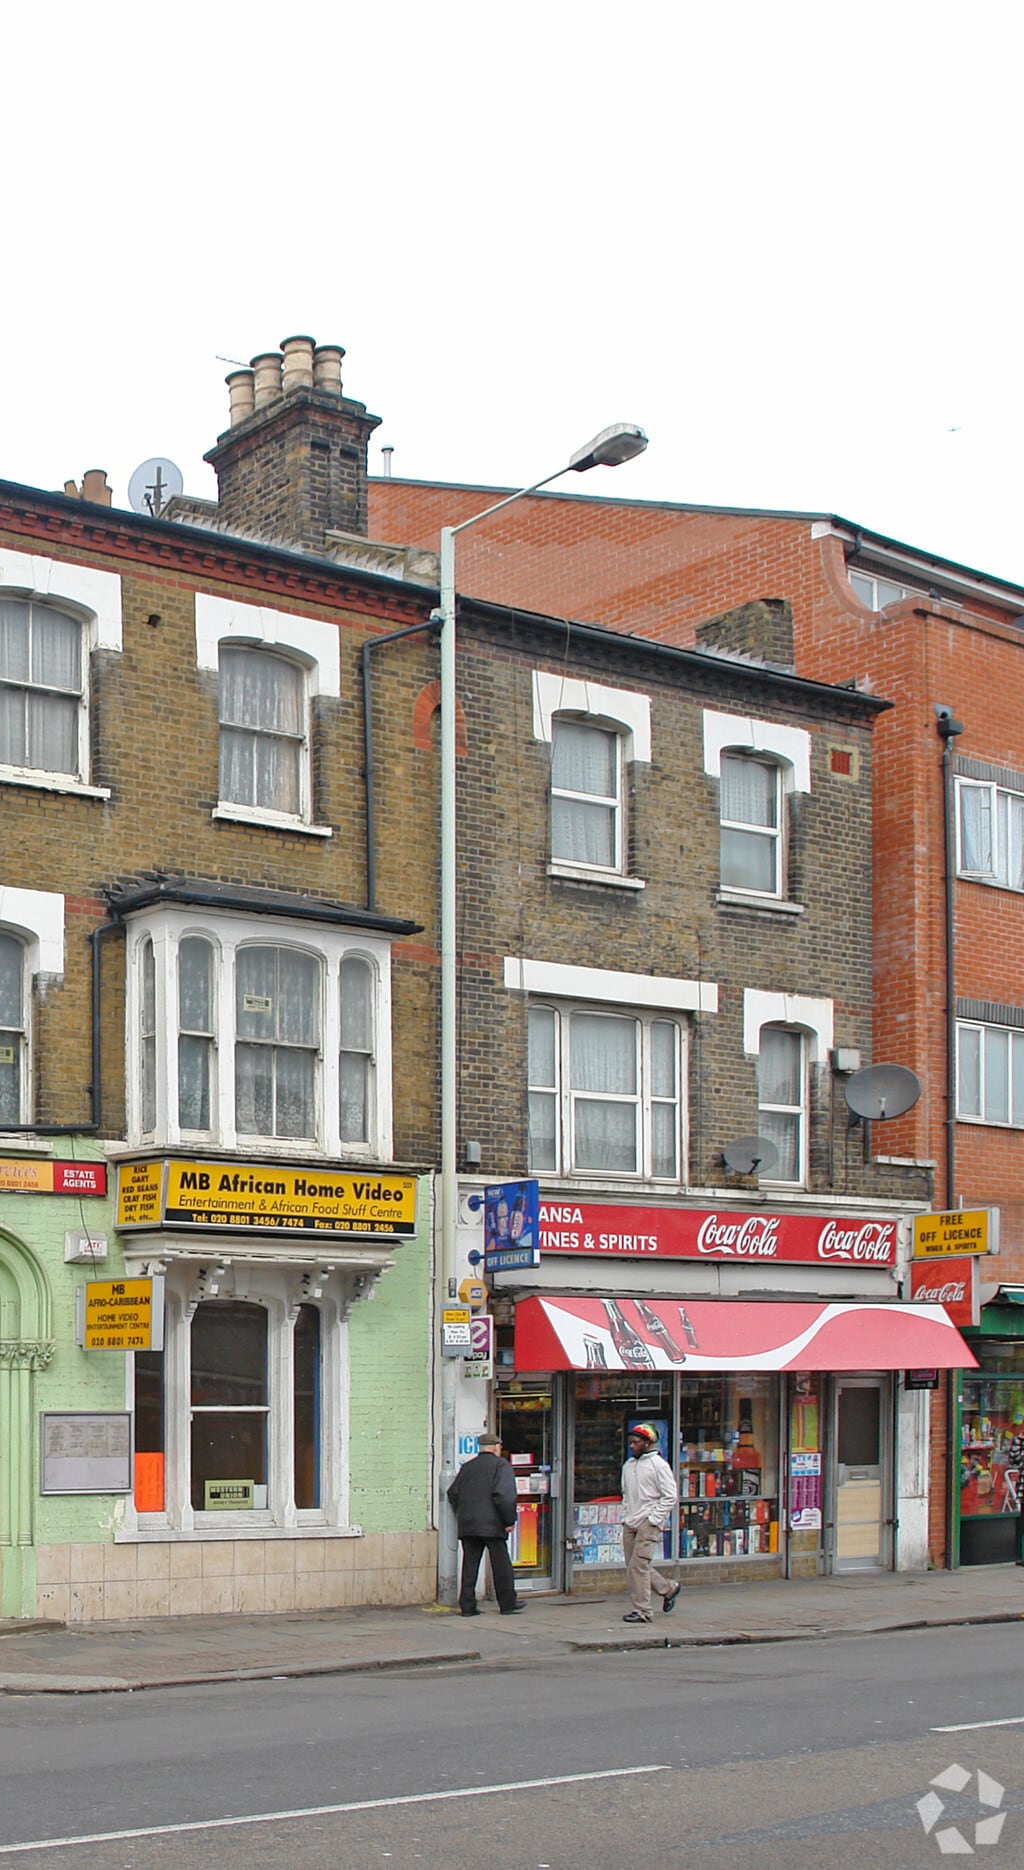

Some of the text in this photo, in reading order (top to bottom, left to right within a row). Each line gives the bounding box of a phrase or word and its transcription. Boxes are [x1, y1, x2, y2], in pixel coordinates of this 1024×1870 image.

[63, 1169, 95, 1180] ESTATE
[134, 1165, 147, 1174] RICE
[63, 1179, 97, 1189] AGENTS
[122, 1183, 158, 1194] RED BEANS
[179, 1171, 403, 1202] MB African Home Video
[123, 1193, 157, 1203] CRAY FISH
[124, 1203, 154, 1212] DRY FISH
[178, 1194, 403, 1218] Entertainment & African Food Stuff Centre
[538, 1206, 584, 1224] ANSA
[939, 1214, 963, 1226] FREE
[192, 1213, 208, 1222] Tel:
[210, 1214, 227, 1223] 020
[229, 1215, 250, 1224] 8801
[282, 1218, 304, 1228] 7474
[314, 1220, 332, 1229] Fax:
[334, 1221, 350, 1230] 020
[352, 1222, 371, 1231] 8801
[374, 1223, 394, 1232] 2456
[696, 1214, 781, 1257] Coca-Cola
[919, 1227, 983, 1243] OFF LICENCE
[583, 1232, 595, 1249] &
[599, 1234, 657, 1251] SPIRITS
[817, 1220, 895, 1262] Coca-Cola
[954, 1242, 977, 1250] SPIRITS
[487, 1253, 529, 1267] OFF LICENCE
[111, 1284, 125, 1295] MB
[914, 1281, 966, 1303] Coca-Cola
[88, 1296, 150, 1307] AFRO-CARIBBEAN
[97, 1313, 139, 1322] HOME VIDEO
[87, 1322, 128, 1330] ENTERTAINMENT
[91, 1337, 144, 1346] 020 8801 7474
